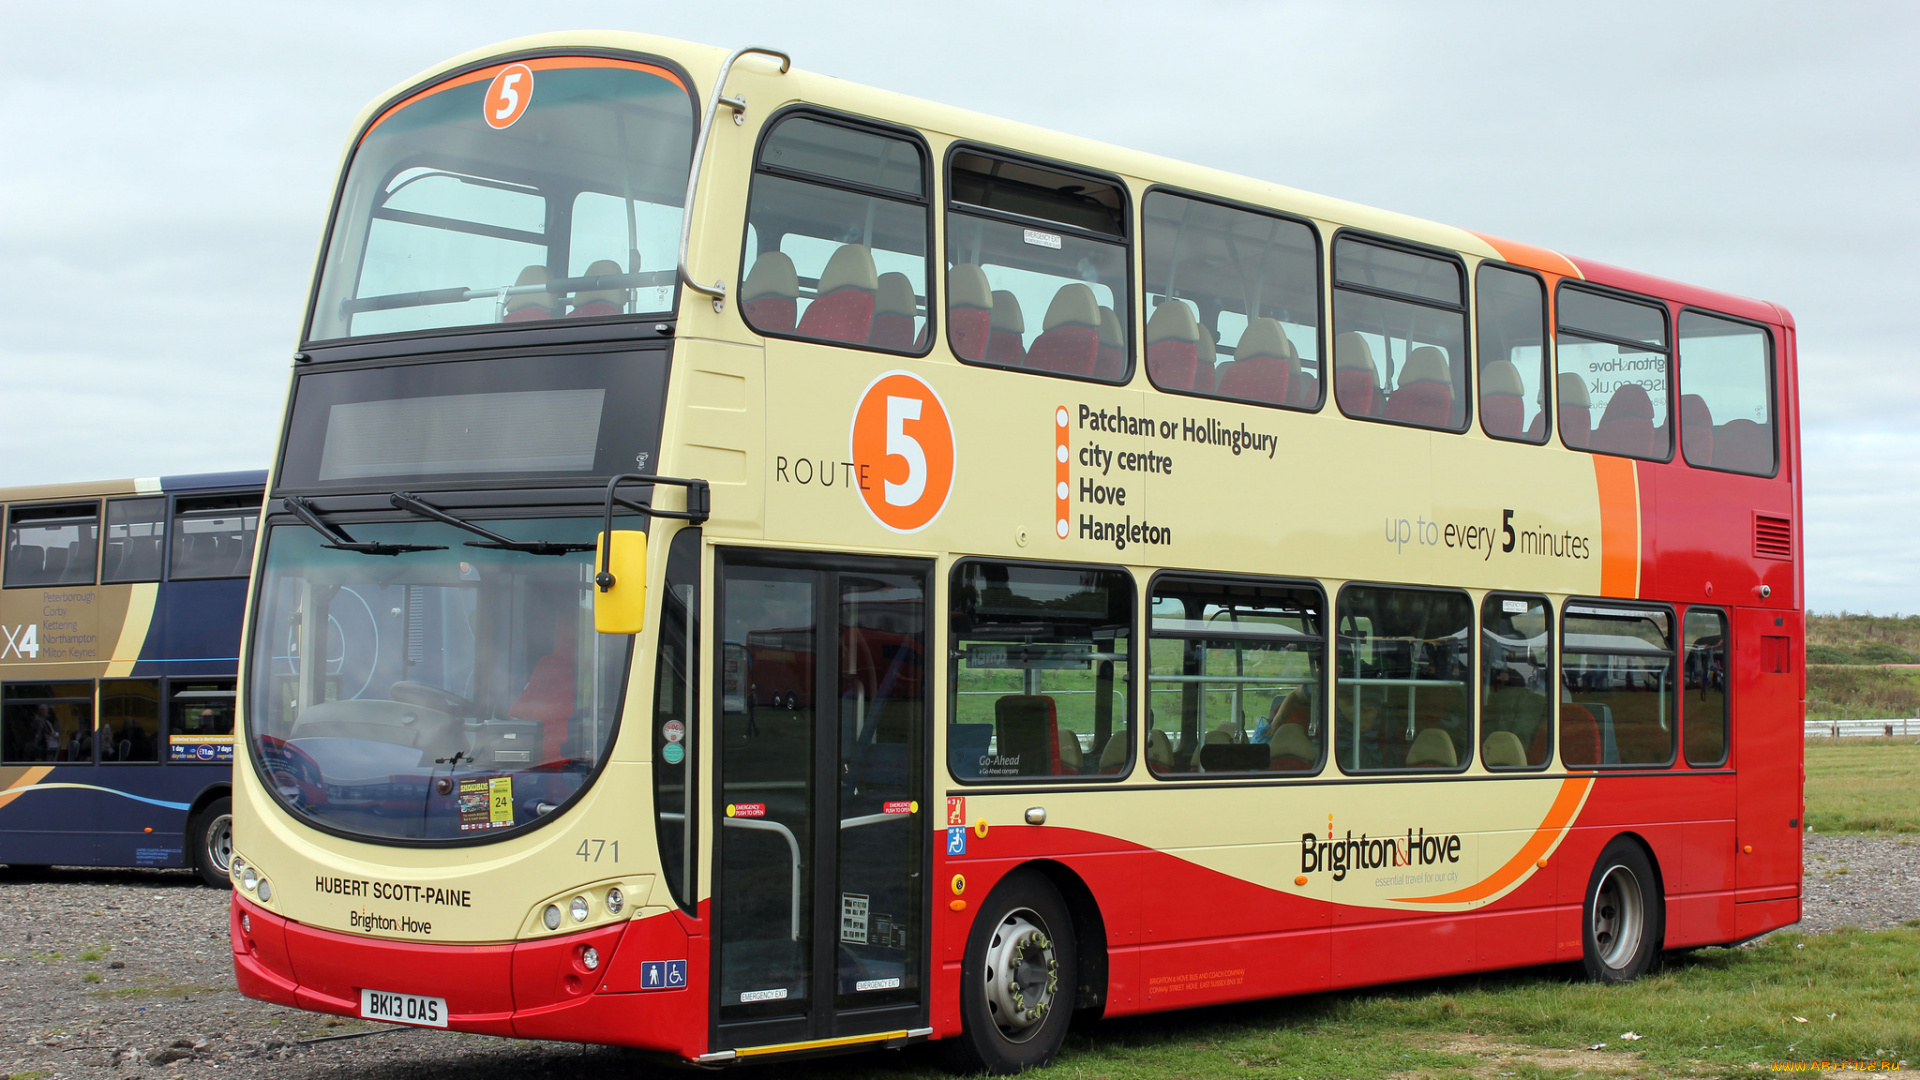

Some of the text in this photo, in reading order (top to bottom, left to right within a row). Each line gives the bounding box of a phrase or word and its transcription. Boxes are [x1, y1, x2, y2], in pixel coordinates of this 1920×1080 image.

[495, 73, 523, 120] 5
[1078, 403, 1278, 460] Patcham or Hollingbury
[776, 395, 927, 507] ROUTE 5
[1079, 440, 1172, 476] city centre
[1079, 477, 1126, 506] Hove
[1079, 513, 1171, 550] Hangleton
[1385, 508, 1590, 562] up to every 5 minutes
[43, 591, 96, 604] Peterborough
[43, 605, 67, 618] Corby
[43, 620, 77, 632] Kettering
[1, 624, 39, 659] X4
[42, 634, 96, 646] Northampton
[42, 647, 96, 659] Milton Keynes
[175, 745, 184, 753] day
[221, 745, 232, 753] days
[979, 754, 1020, 766] Go-Ahead
[495, 796, 507, 808] 24
[575, 839, 619, 863] 471
[1375, 870, 1459, 887] essential travel for our city
[315, 876, 471, 908] HUBERT SCOTT-PAINE
[857, 979, 899, 990] EMERGENCY EXIT
[1149, 976, 1172, 985] BRIGHTON
[1176, 974, 1189, 982] HOVE
[1199, 972, 1208, 980] AND
[1209, 970, 1224, 979] COACH
[1224, 968, 1245, 977] COMPANY
[741, 989, 787, 1001] EMERGENCY EXIT
[1149, 985, 1168, 994] CONWAY
[1169, 983, 1184, 993] STREET
[1186, 982, 1198, 990] HOVE
[1210, 979, 1226, 988] SUSSEX
[370, 993, 438, 1022] BK13 OAS
